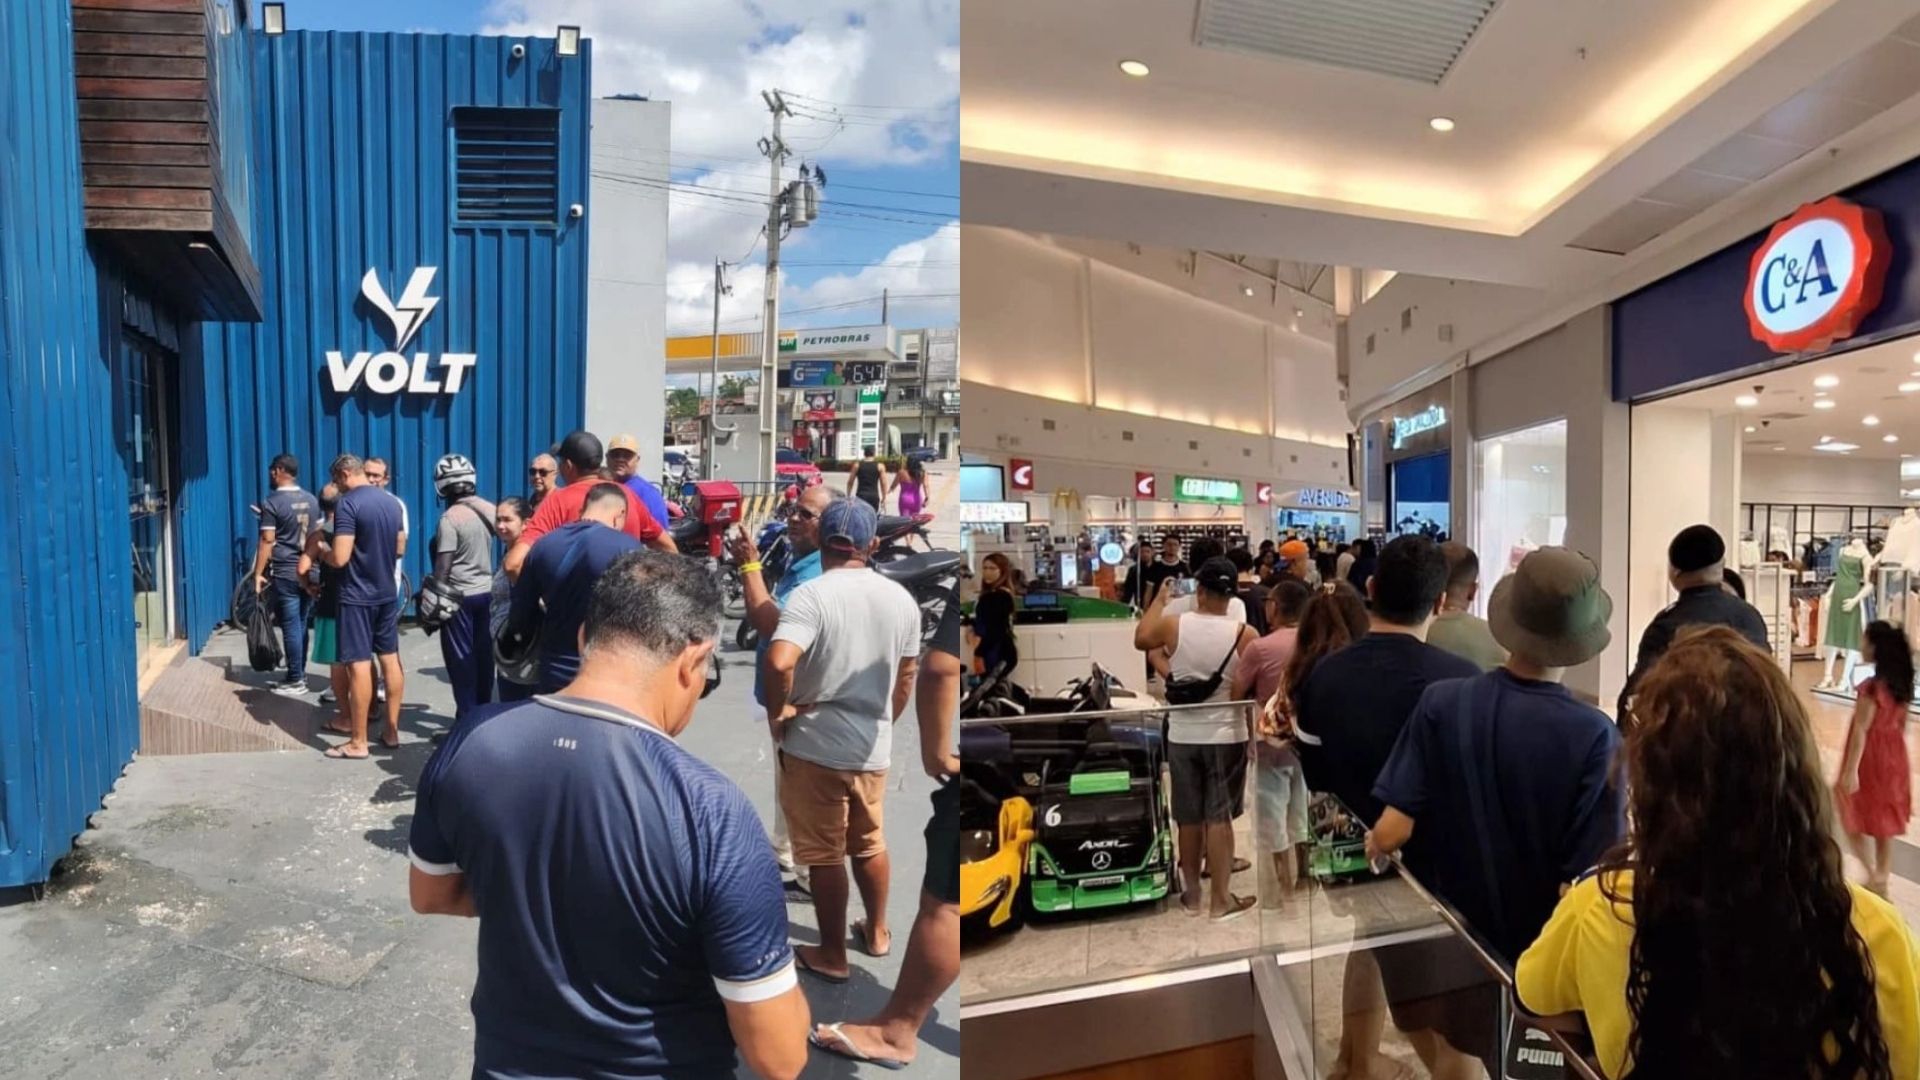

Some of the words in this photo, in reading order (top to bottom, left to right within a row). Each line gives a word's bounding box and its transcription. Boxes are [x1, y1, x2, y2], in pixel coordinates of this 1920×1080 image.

[1760, 238, 1838, 315] C&A
[803, 333, 871, 345] PETROBRAS
[325, 350, 477, 394] VOLT
[1299, 488, 1351, 507] AVENIDA
[1045, 803, 1062, 827] 6
